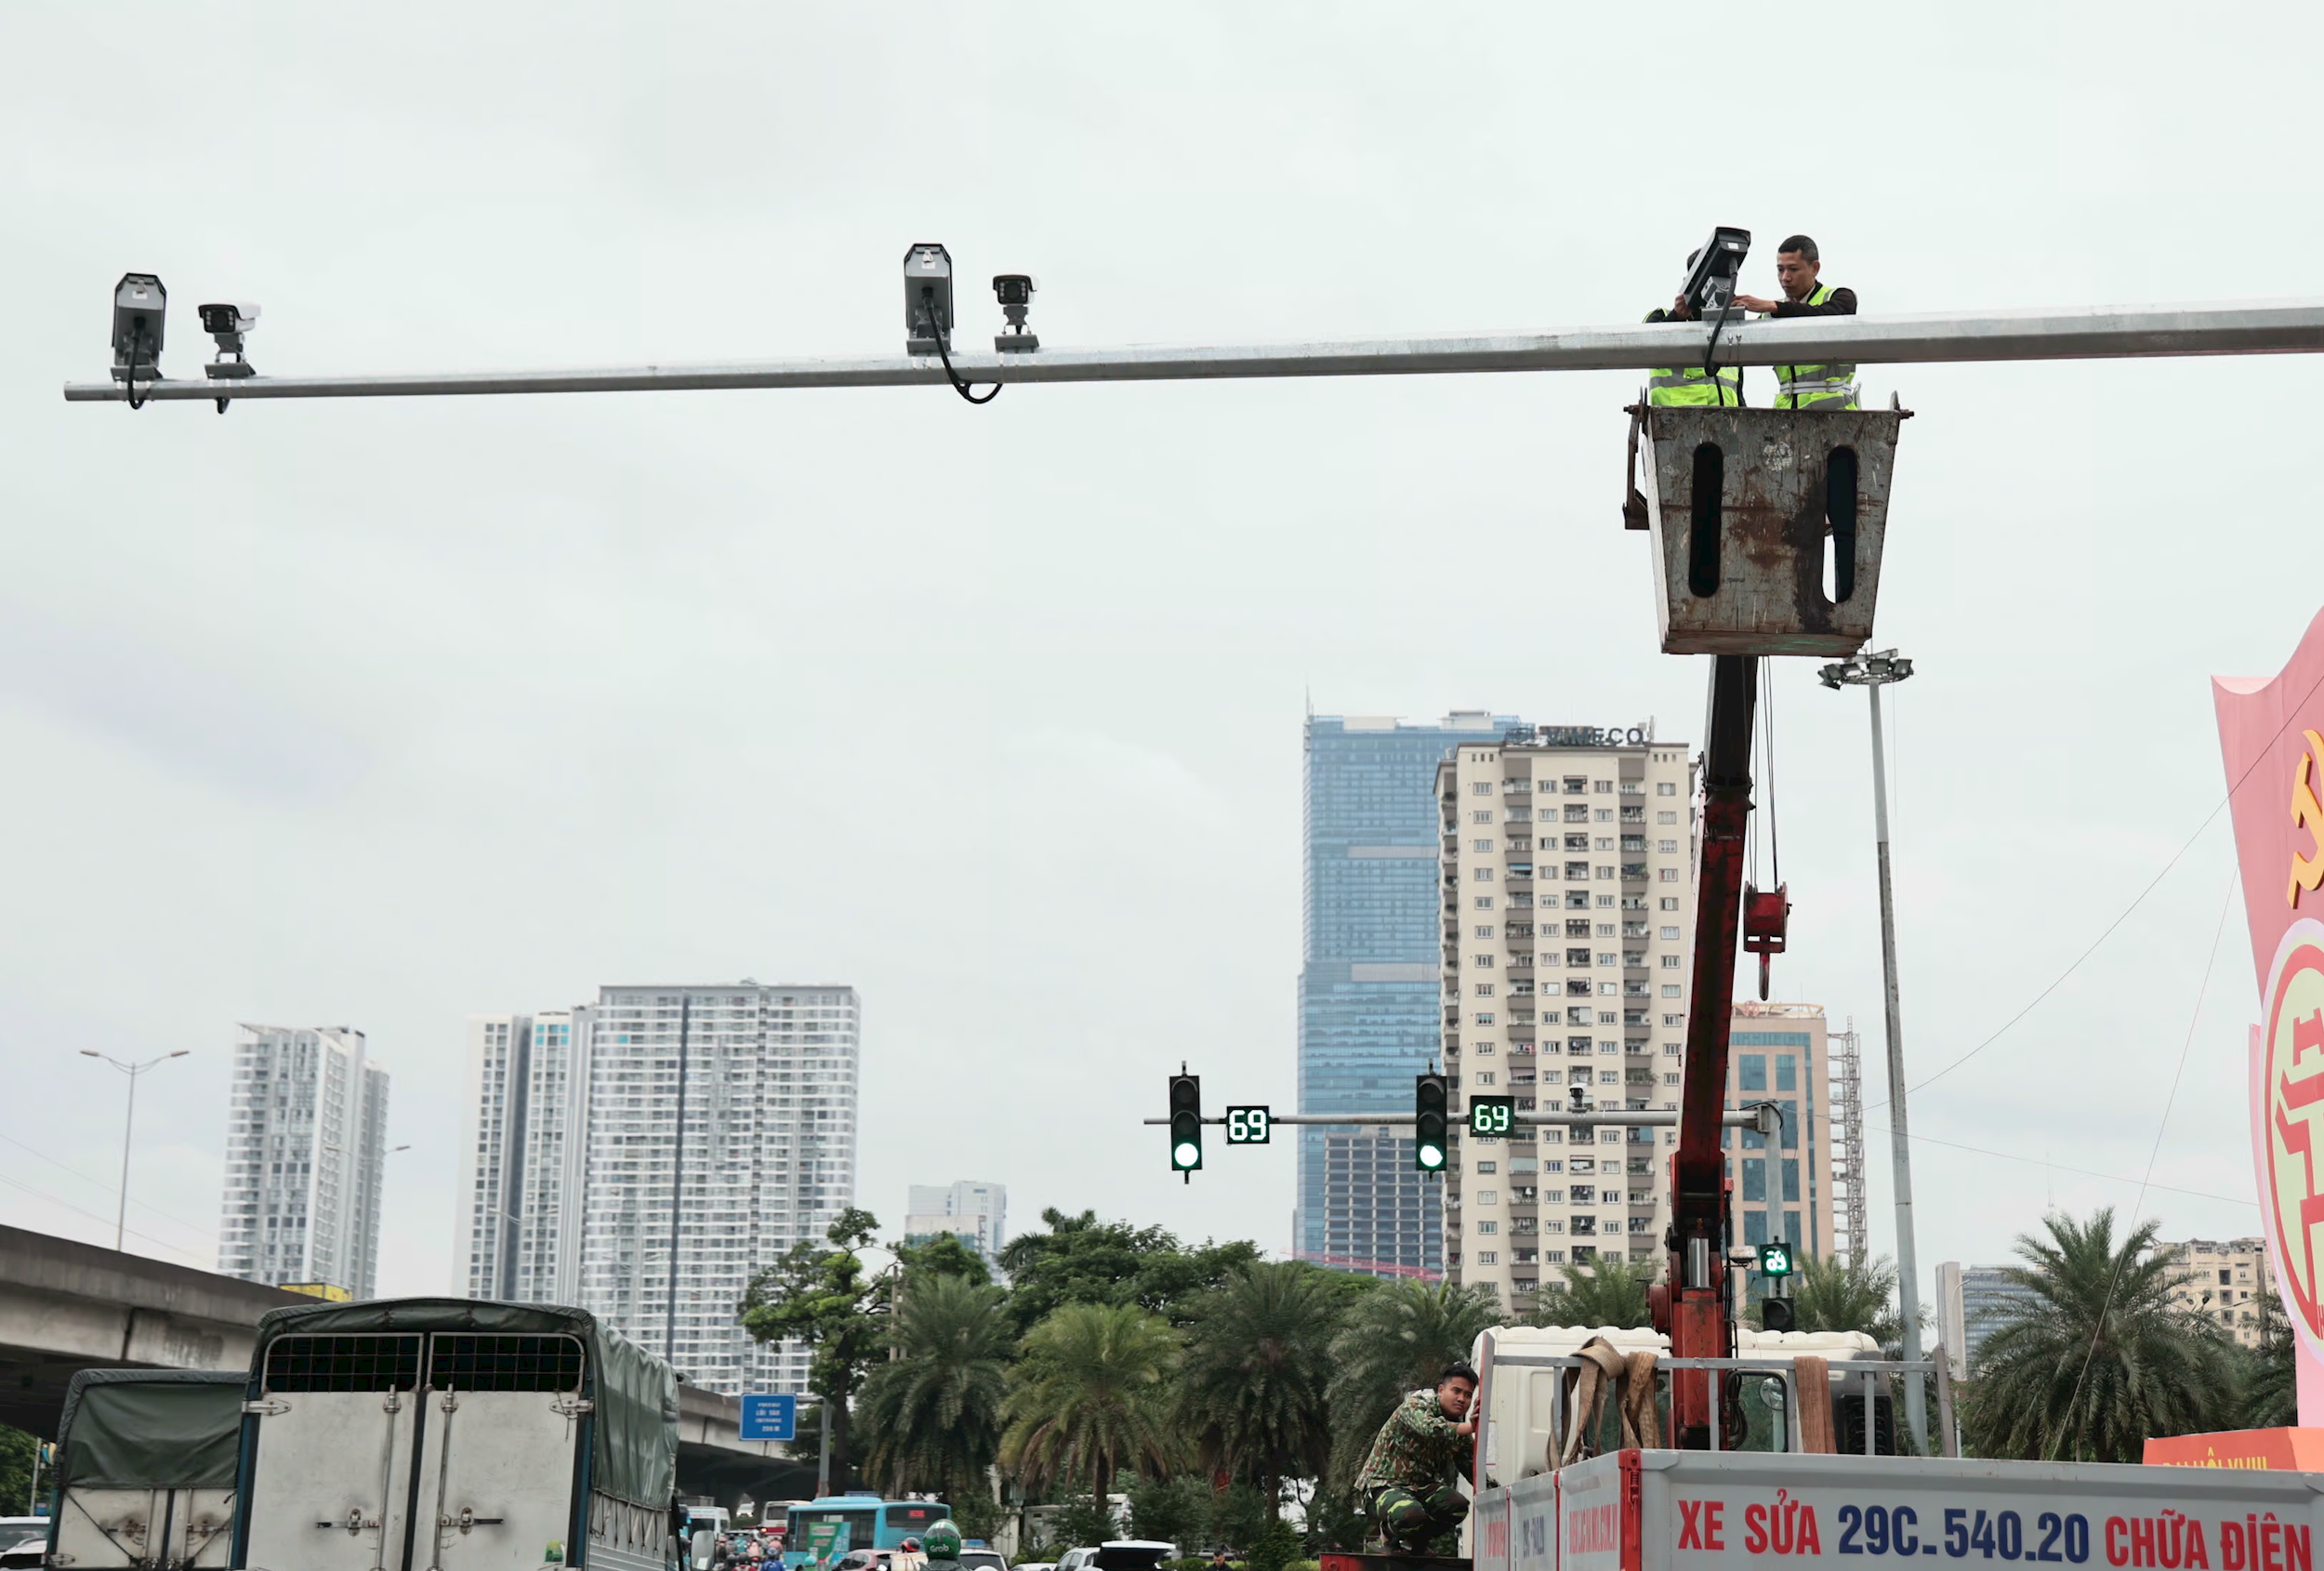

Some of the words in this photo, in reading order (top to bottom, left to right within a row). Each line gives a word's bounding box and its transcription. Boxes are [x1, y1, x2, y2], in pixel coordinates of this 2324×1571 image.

[1229, 1109, 1266, 1141] 69
[1475, 1104, 1509, 1131] 69
[1678, 1499, 1724, 1551] XE
[1745, 1488, 1821, 1555] SỬA
[2105, 1509, 2210, 1570] CHỮA
[930, 1544, 949, 1552] Grab
